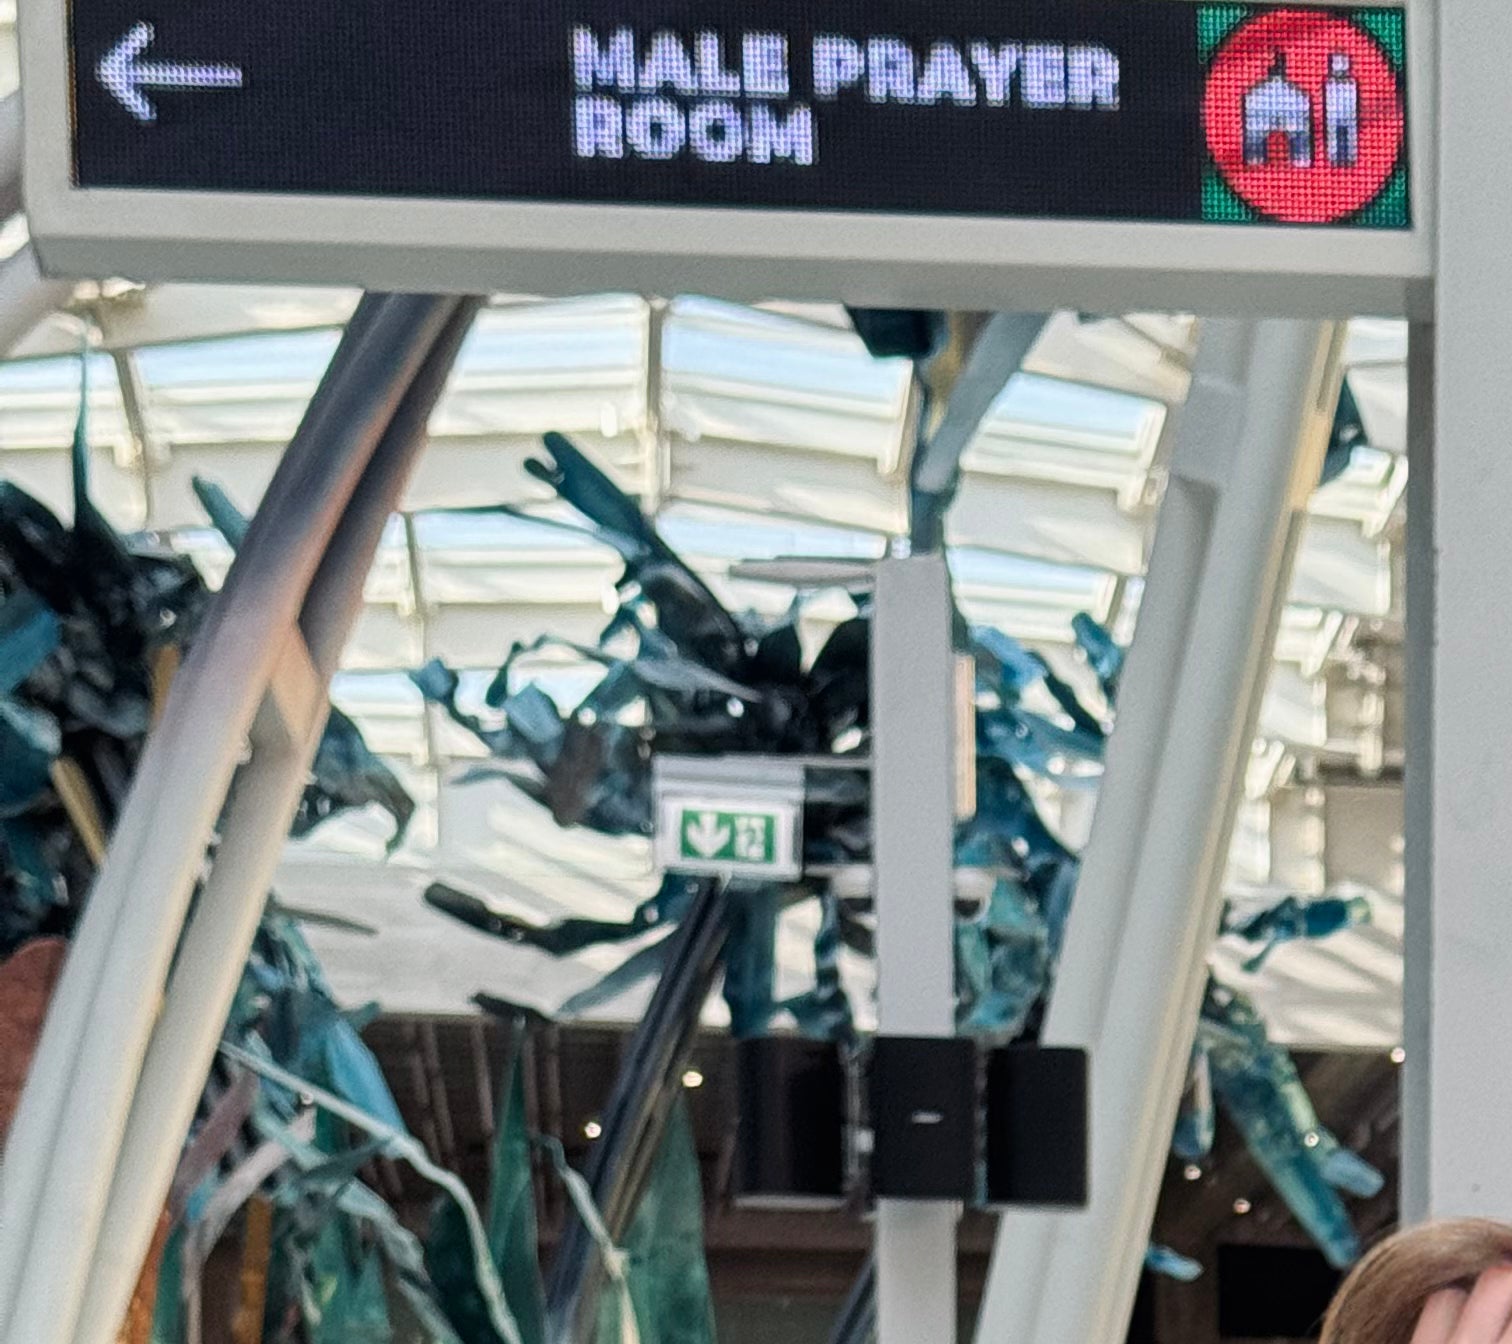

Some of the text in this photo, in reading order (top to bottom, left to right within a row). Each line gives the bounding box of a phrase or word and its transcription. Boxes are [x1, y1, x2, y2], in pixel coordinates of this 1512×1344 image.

[572, 25, 1121, 110] MALE PRAYER
[574, 95, 815, 165] ROOM
